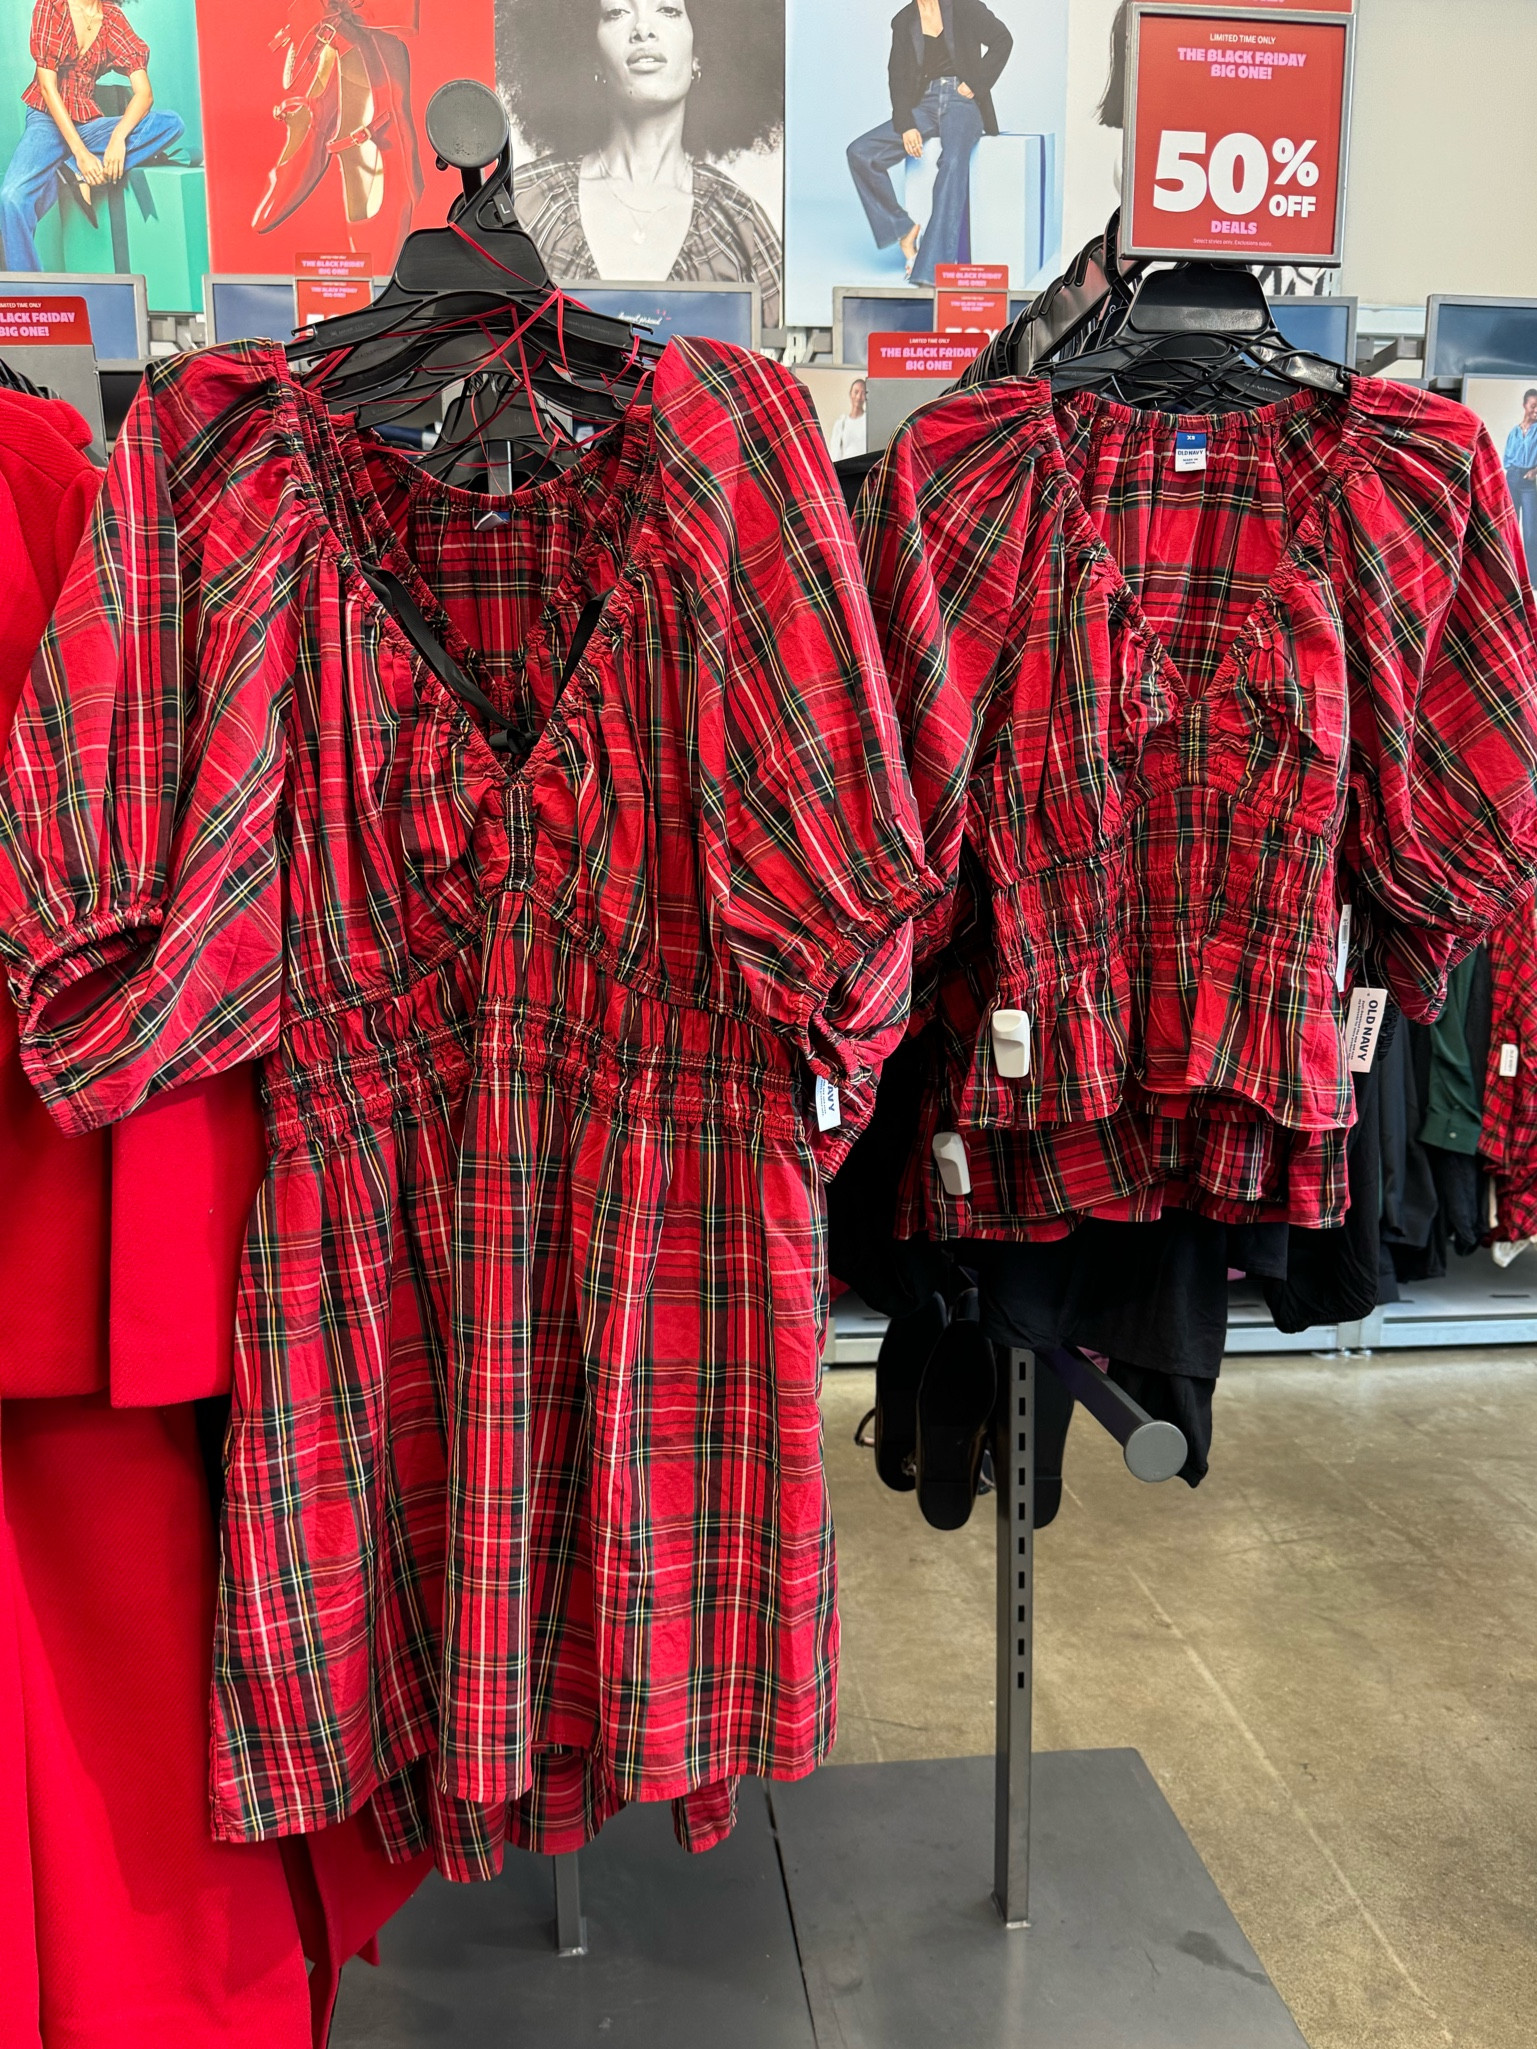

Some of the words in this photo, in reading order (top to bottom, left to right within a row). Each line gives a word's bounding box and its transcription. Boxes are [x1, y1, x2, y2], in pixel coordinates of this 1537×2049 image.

[1209, 33, 1239, 43] LIMITED
[1239, 34, 1256, 44] TIME
[1257, 36, 1277, 45] ONLY
[1177, 47, 1206, 62] THE
[1207, 48, 1254, 64] BLACK
[1255, 51, 1307, 67] FRIDAY
[1210, 64, 1236, 78] BIG
[1237, 65, 1273, 80] ONE!
[1268, 194, 1317, 218] OFF
[1210, 220, 1258, 235] DEALS
[316, 260, 339, 268] BLACK
[0, 312, 31, 323] LACK
[32, 312, 76, 323] FRIDAY
[19, 326, 50, 337] ONE!
[880, 347, 902, 358] THE
[902, 347, 938, 358] BLACK
[939, 347, 979, 358] FRIDAY
[905, 360, 925, 371] BIG
[926, 360, 953, 371] ONE!
[1366, 999, 1379, 1025] OLD
[1357, 1026, 1374, 1062] NAVY
[827, 1085, 835, 1111] AVY
